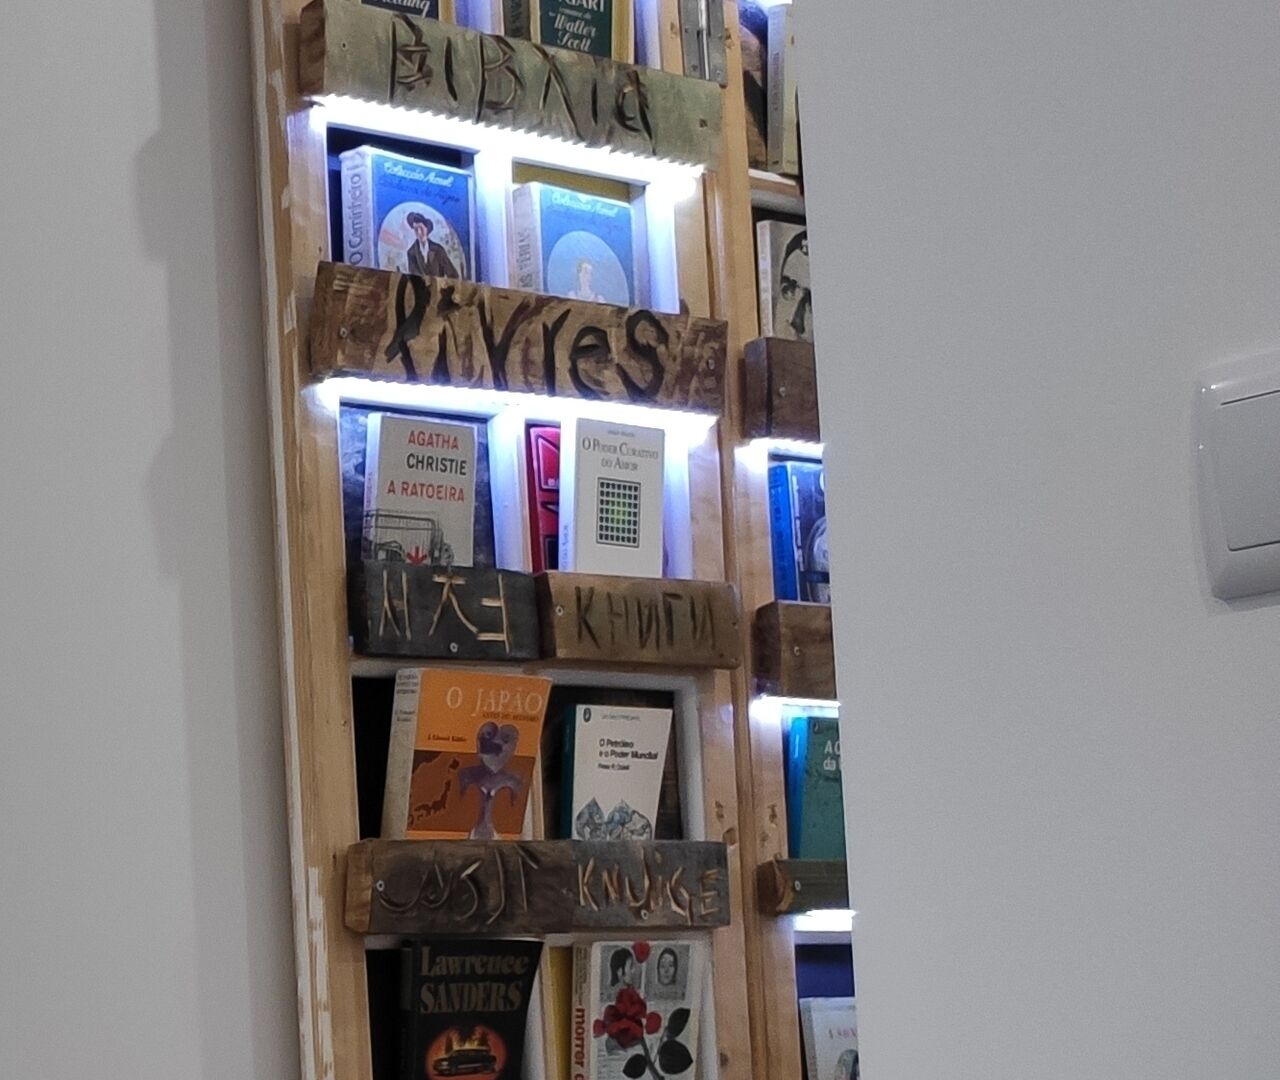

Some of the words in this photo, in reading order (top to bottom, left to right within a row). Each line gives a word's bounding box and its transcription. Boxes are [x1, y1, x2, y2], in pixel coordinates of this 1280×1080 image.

[554, 13, 597, 39] Walter
[556, 31, 592, 52] Scott
[408, 430, 460, 451] AGATHA
[581, 438, 591, 451] O
[406, 453, 468, 476] CHRISTIE
[386, 480, 396, 495] A
[400, 481, 465, 503] RATOEIRA
[446, 686, 463, 709] O
[471, 687, 543, 716] JAPÃO
[599, 738, 605, 747] O
[421, 946, 529, 976] Lawrence
[420, 981, 523, 1014] SANDERS
[574, 1007, 586, 1069] morrer
